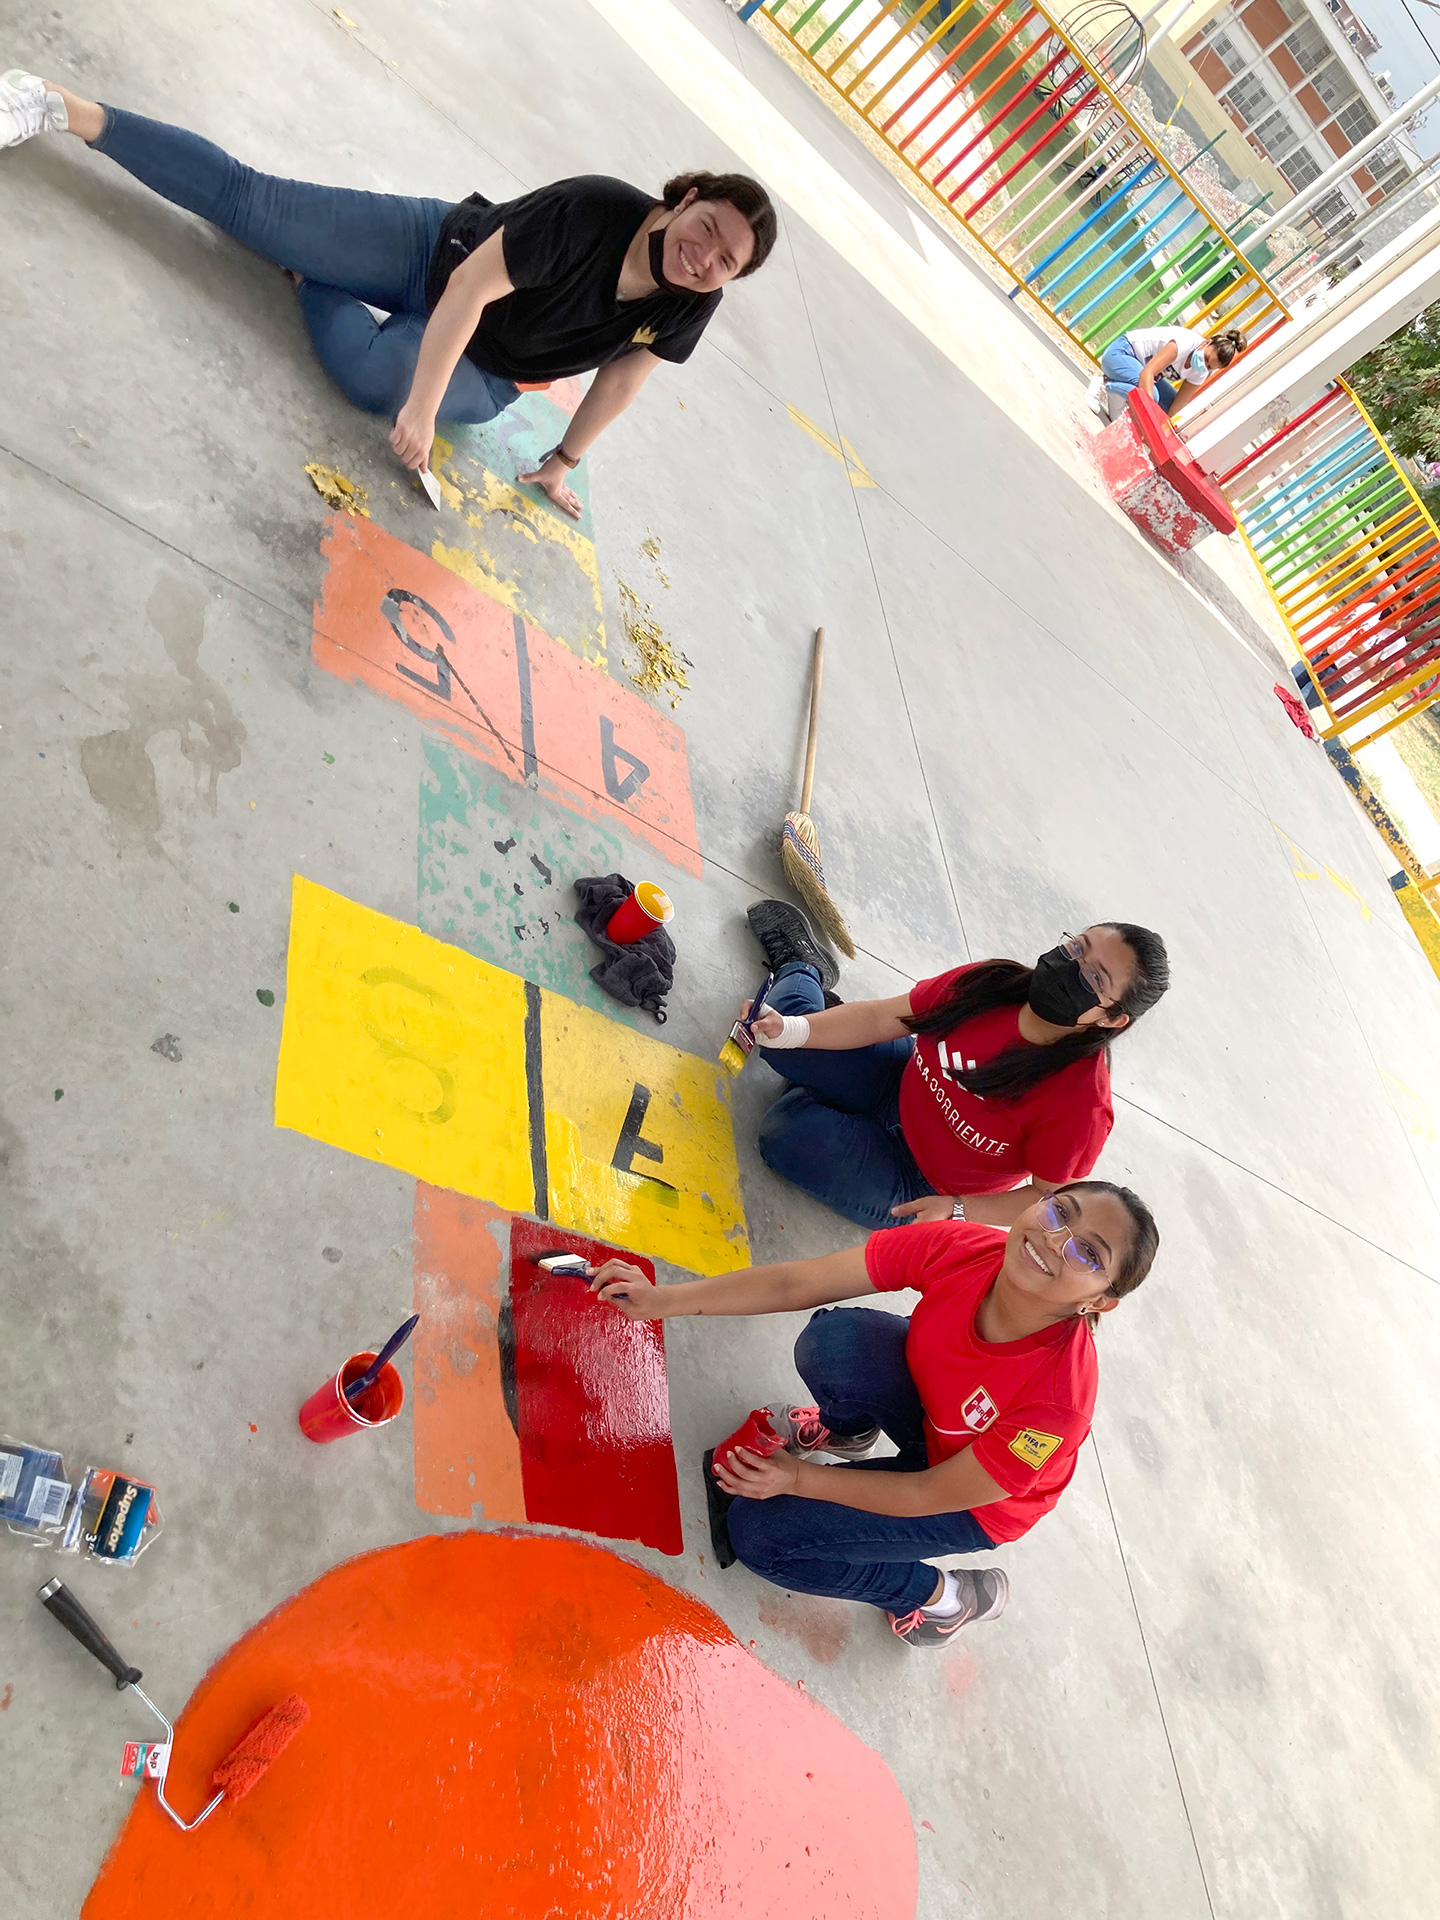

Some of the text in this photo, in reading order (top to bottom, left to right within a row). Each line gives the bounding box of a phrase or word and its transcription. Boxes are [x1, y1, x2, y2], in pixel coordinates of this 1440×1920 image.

[381, 588, 457, 701] 5
[599, 714, 650, 803] 4
[912, 1040, 1010, 1154] TRACORRIENTE
[971, 1399, 989, 1422] PERU
[1023, 1433, 1039, 1448] FIFA
[108, 1485, 138, 1553] Superior
